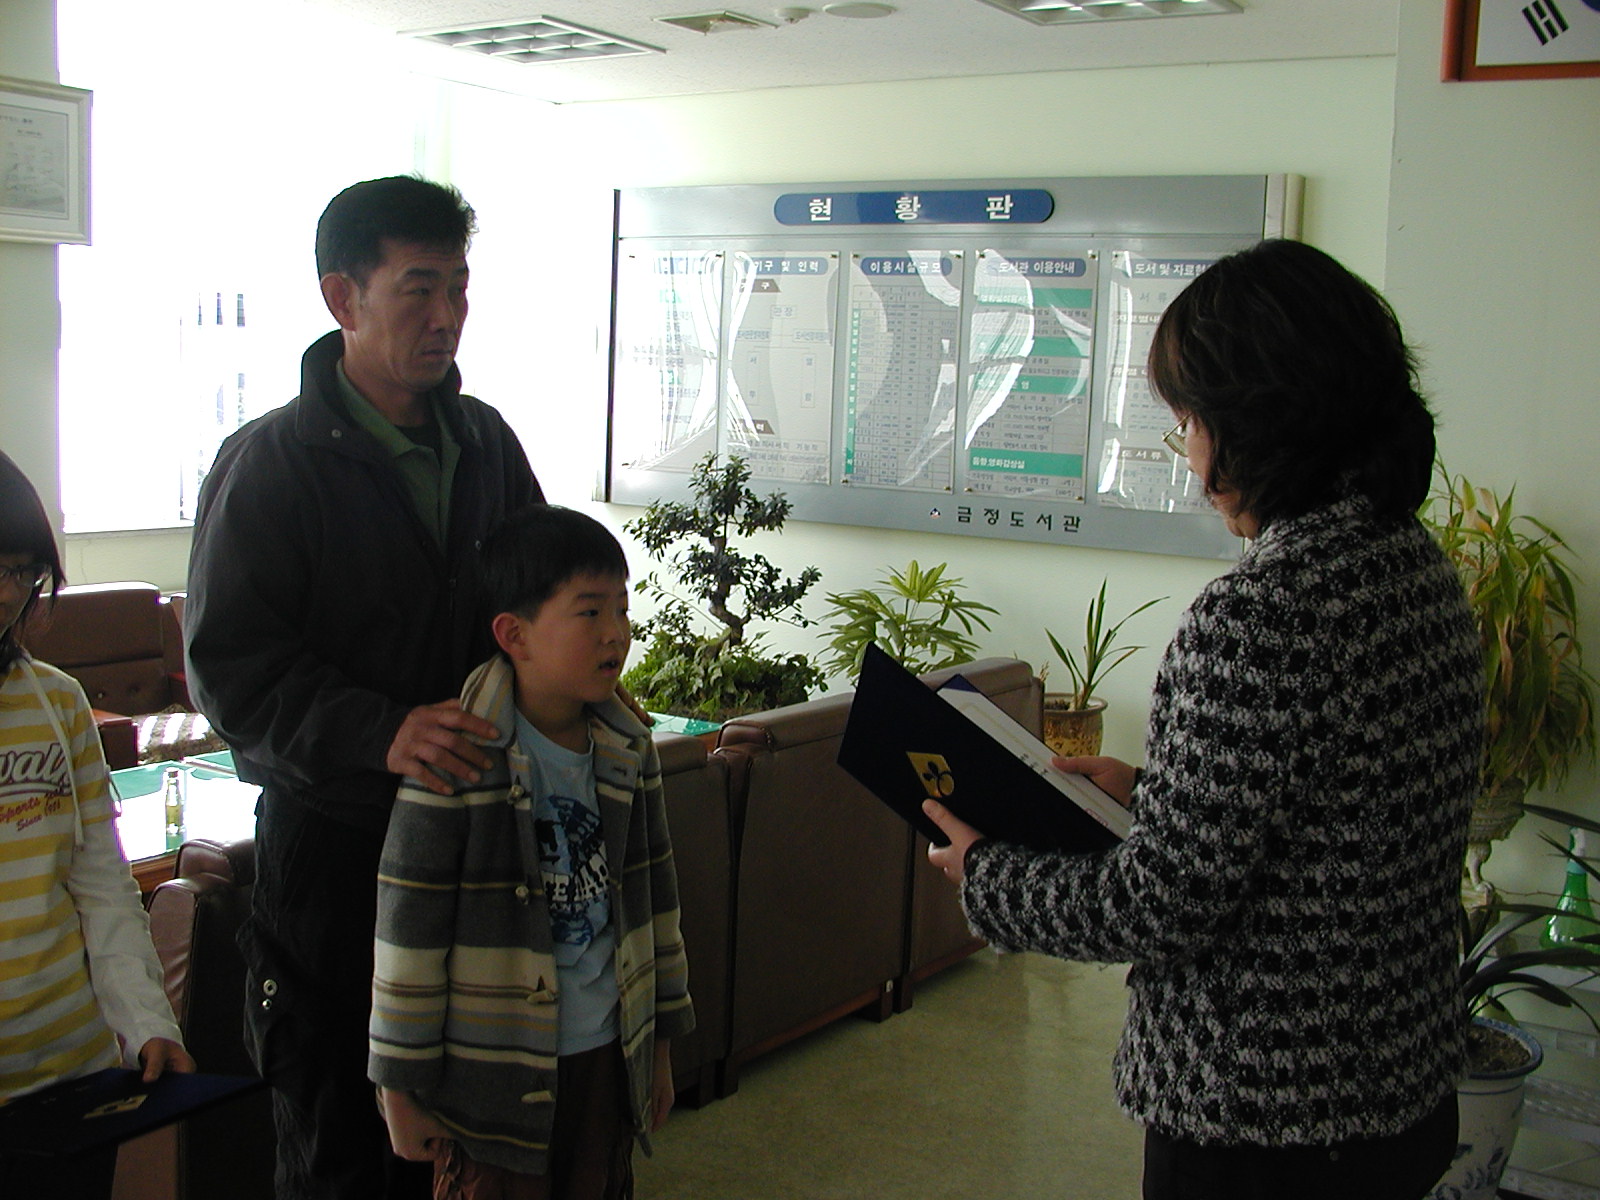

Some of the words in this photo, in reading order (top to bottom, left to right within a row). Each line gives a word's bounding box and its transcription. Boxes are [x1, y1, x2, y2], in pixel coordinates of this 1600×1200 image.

[808, 196, 833, 223] 현
[895, 195, 922, 222] 황
[985, 194, 1014, 220] 판
[781, 260, 791, 272] 및
[998, 261, 1029, 274] 도서관
[1034, 261, 1075, 274] 이용안내
[1134, 262, 1156, 275] 도서
[1159, 262, 1170, 276] 및
[1172, 262, 1212, 277] 자료현
[957, 506, 1081, 533] 금정도서관
